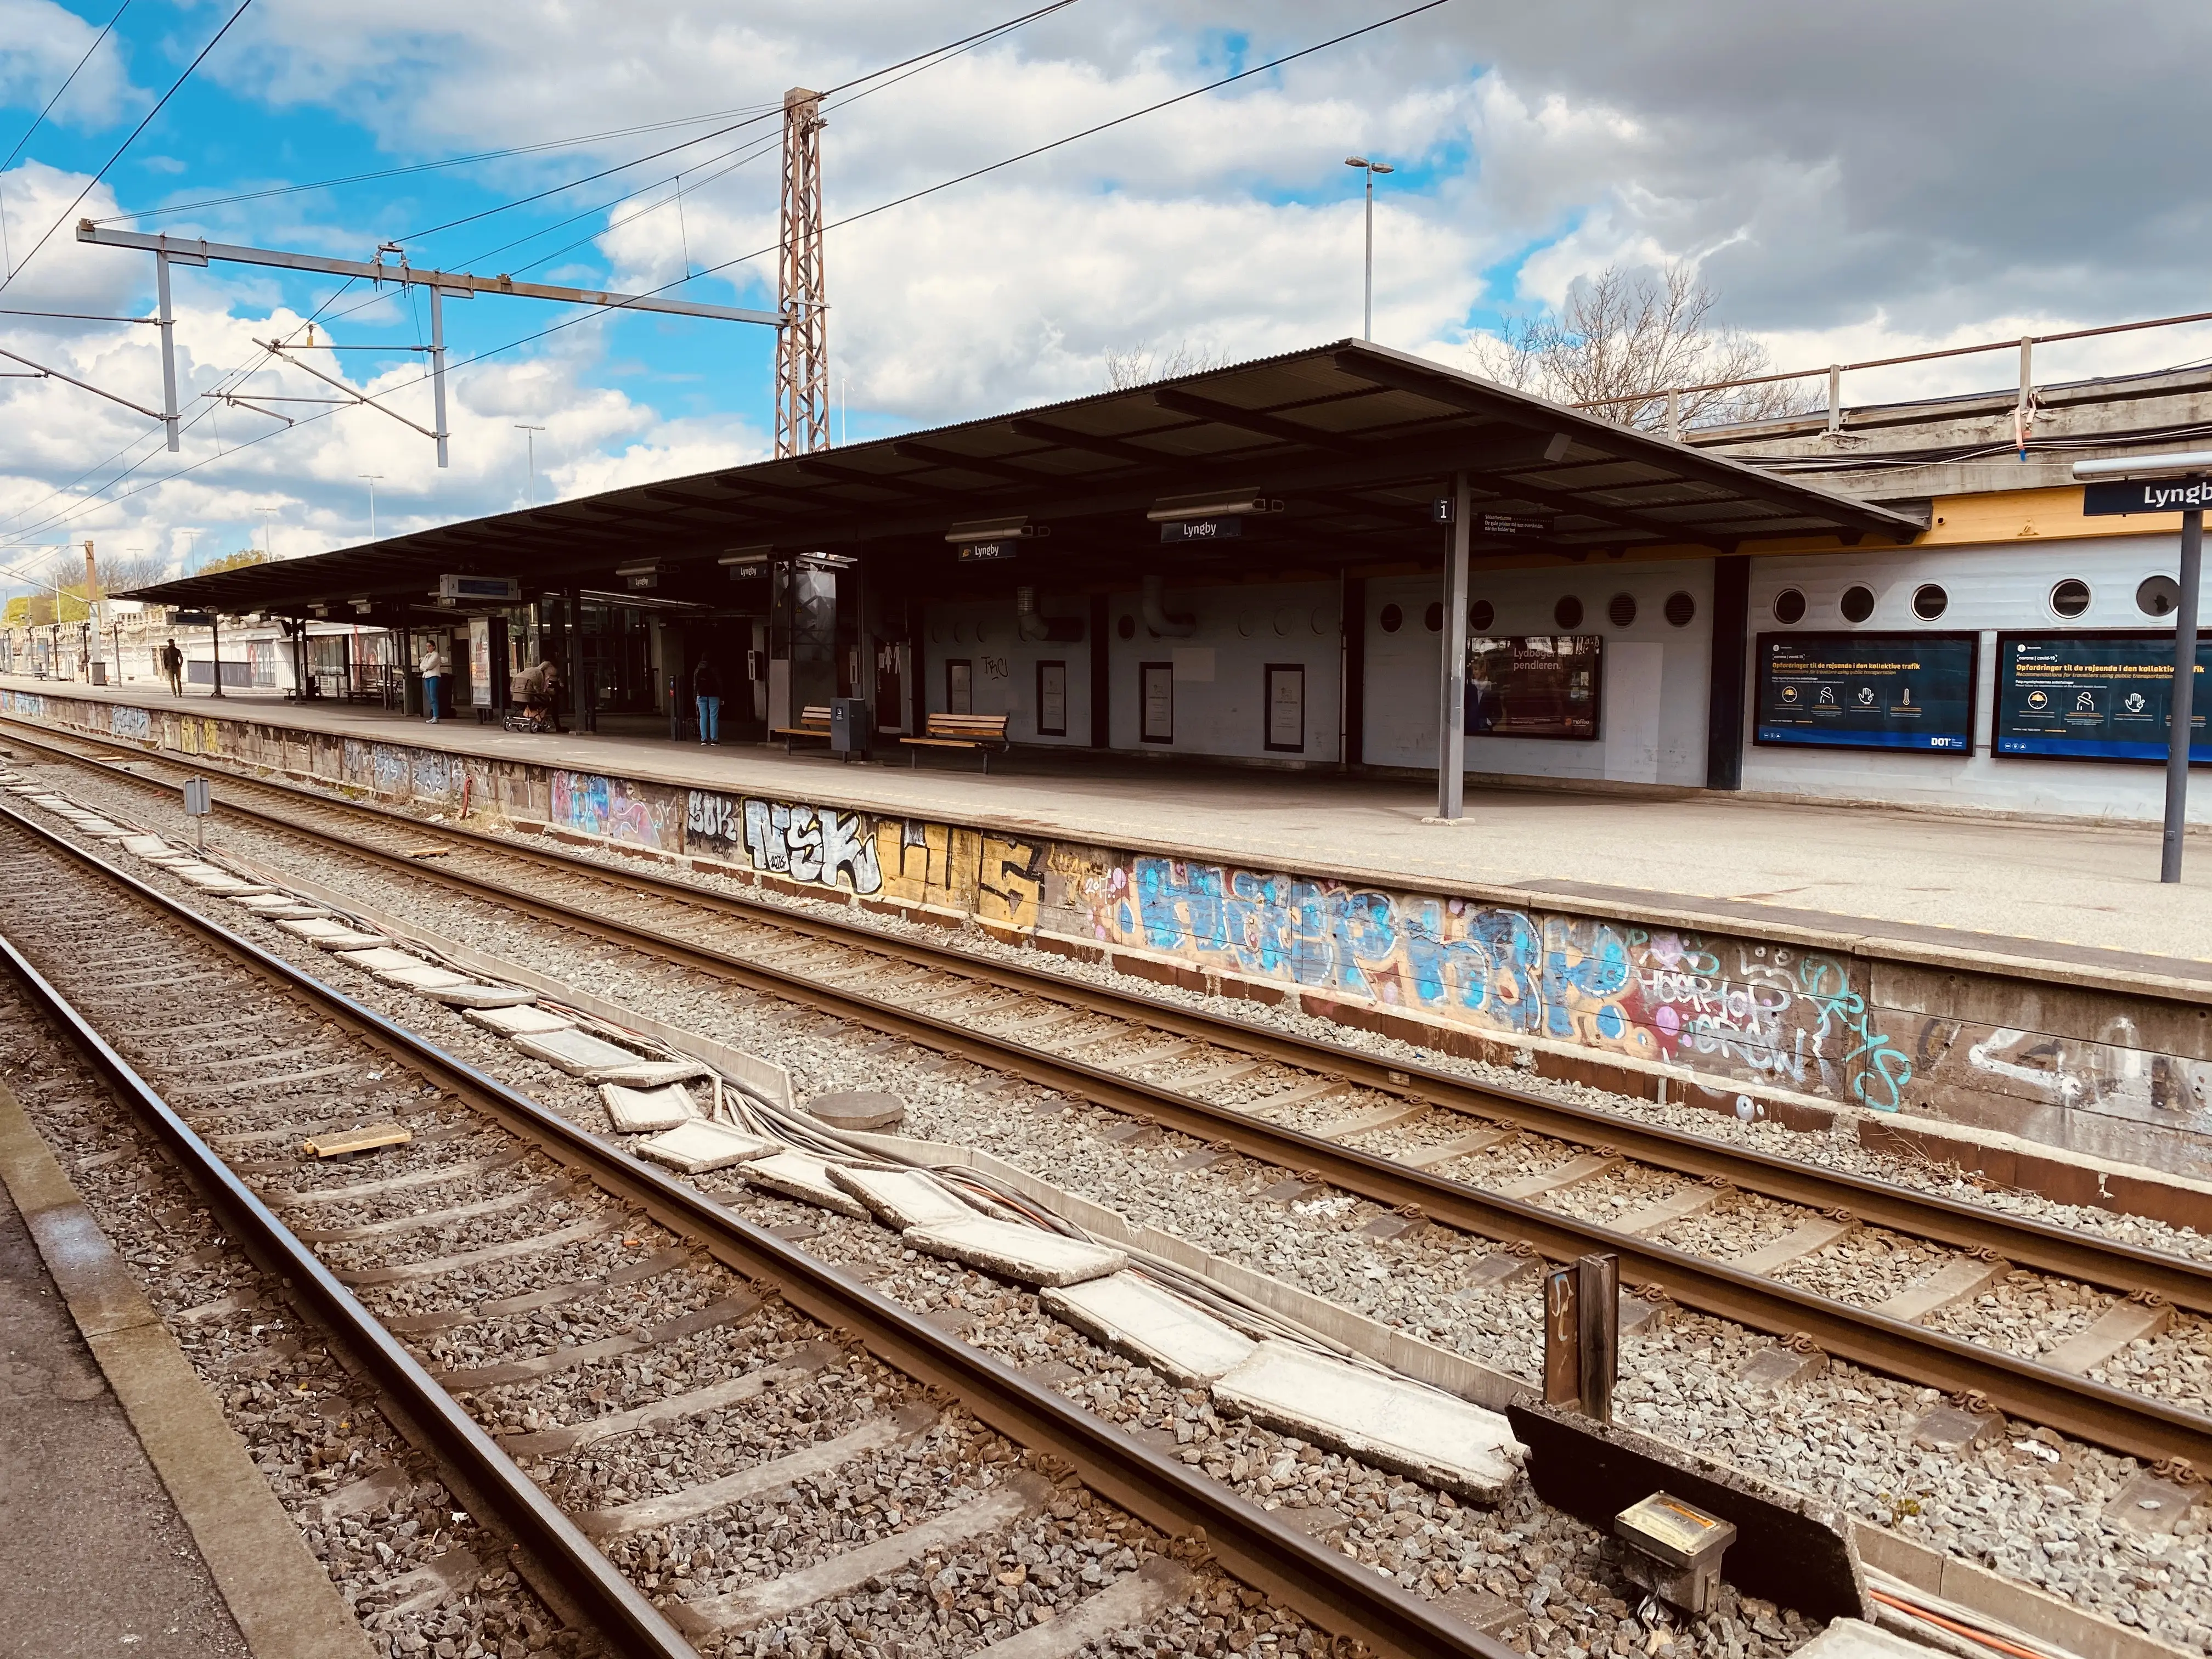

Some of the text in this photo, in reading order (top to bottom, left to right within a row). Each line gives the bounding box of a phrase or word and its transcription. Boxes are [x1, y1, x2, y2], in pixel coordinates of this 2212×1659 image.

[2145, 482, 2212, 507] Lyngb
[1441, 505, 1447, 518] 1
[1184, 521, 1217, 537] Lyngby
[975, 544, 999, 558] Lyngby
[740, 566, 757, 577] Lyngby
[1514, 660, 1561, 672] pendleren.
[2016, 664, 2063, 672] Opfordringer
[2084, 664, 2118, 673] rejsende
[1931, 737, 1950, 747] DOT
